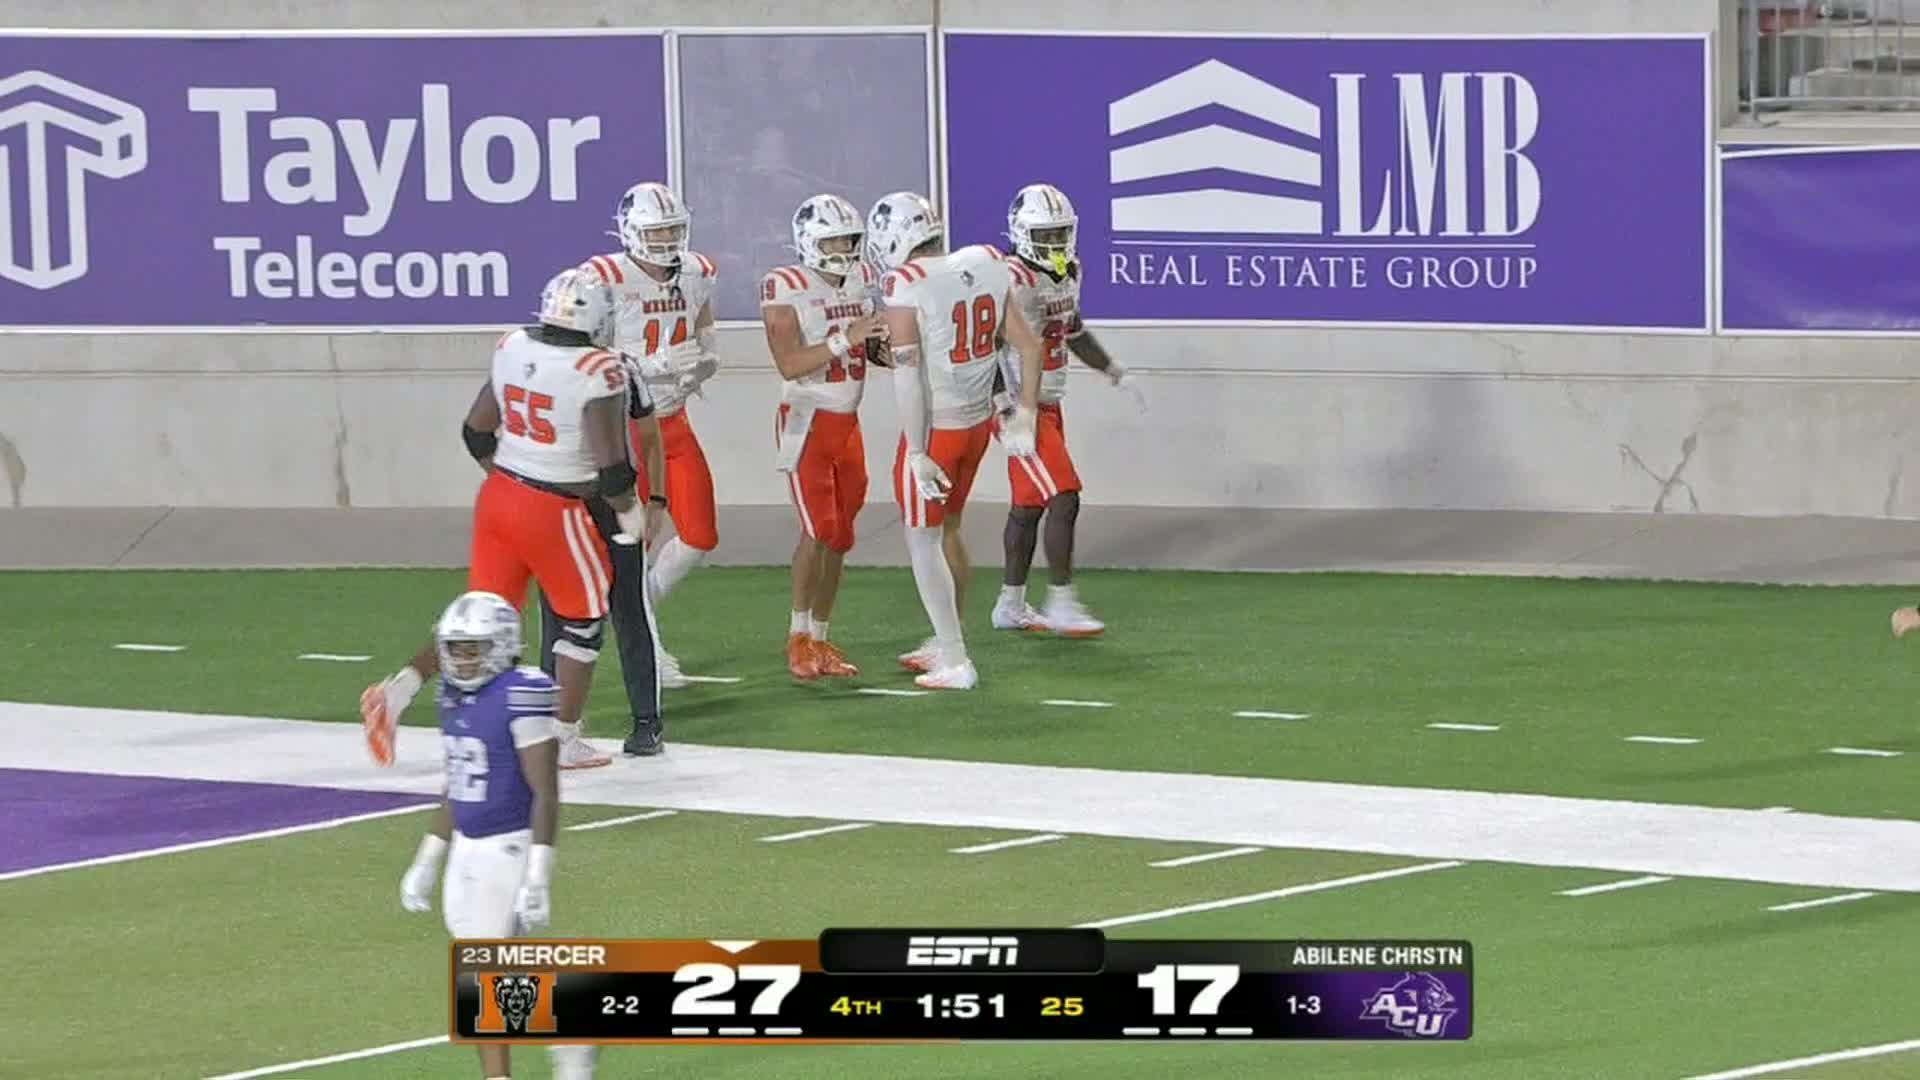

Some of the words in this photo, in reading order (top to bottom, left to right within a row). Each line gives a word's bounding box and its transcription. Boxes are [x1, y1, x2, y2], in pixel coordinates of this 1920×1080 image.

[188, 83, 601, 236] Taylor
[1329, 72, 1541, 236] LMB
[213, 235, 510, 298] Telecom
[1109, 253, 1207, 286] REAL
[1226, 255, 1368, 288] ESTATE
[1386, 256, 1538, 289] GROUP
[642, 316, 688, 357] 14
[951, 294, 998, 363] 18
[503, 383, 557, 445] 55
